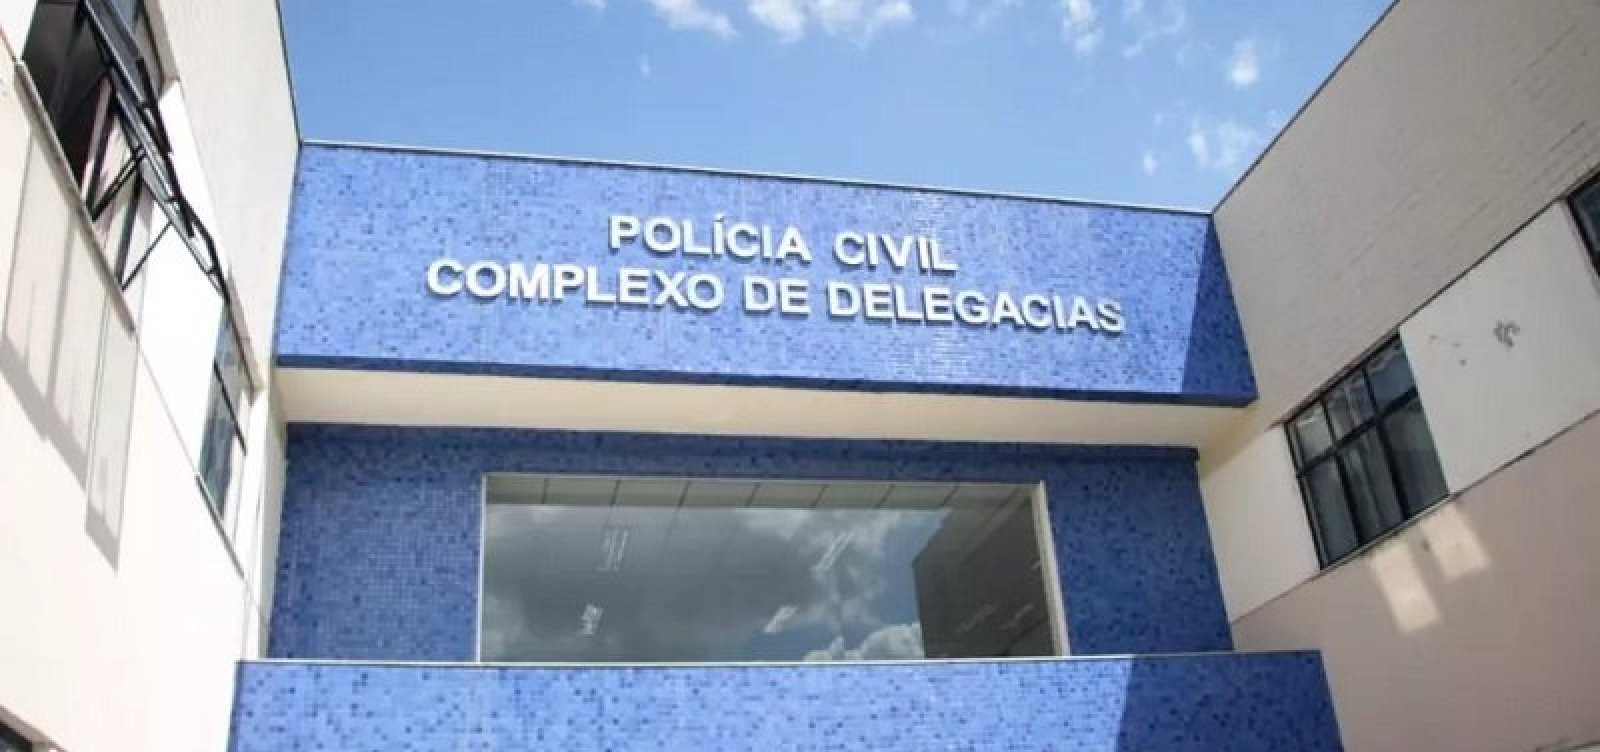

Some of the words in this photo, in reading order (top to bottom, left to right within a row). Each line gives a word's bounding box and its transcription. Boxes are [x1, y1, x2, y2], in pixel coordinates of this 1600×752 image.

[609, 212, 811, 262] POLÍCIA
[832, 231, 959, 273] CIVIL
[426, 257, 724, 311] COMPLEXO
[742, 275, 811, 314] DE
[827, 280, 1125, 334] DELEGACIAS
